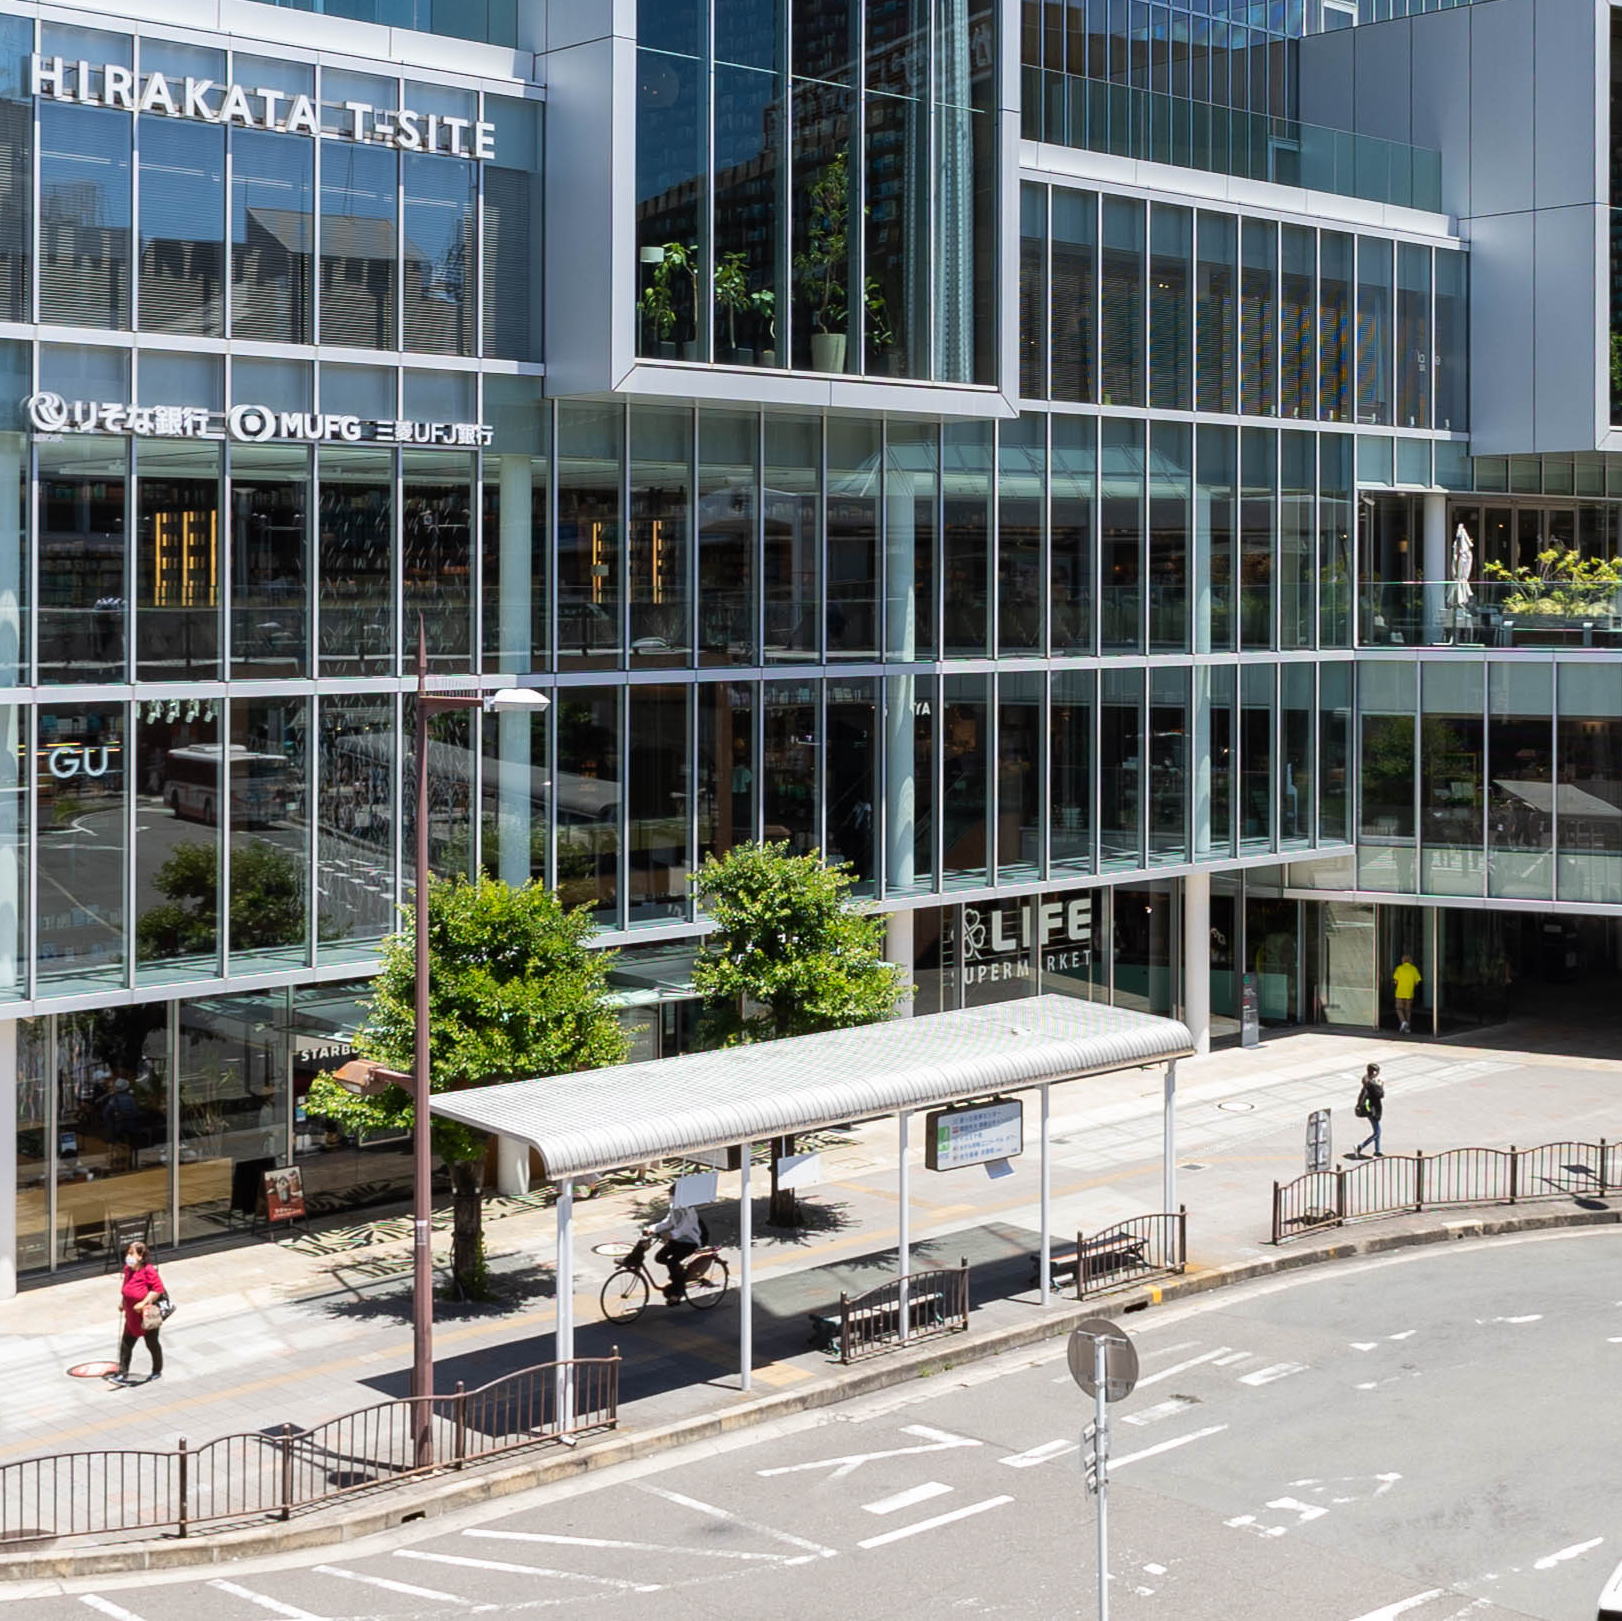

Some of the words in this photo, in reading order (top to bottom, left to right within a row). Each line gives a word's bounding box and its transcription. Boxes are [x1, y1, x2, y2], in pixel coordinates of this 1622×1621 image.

[31, 53, 319, 135] HIRAKATA
[345, 101, 496, 160] T-SITE
[74, 400, 210, 437] りそな銀行
[281, 412, 362, 441] MUFG
[375, 419, 494, 446] 三菱UFJ銀行
[49, 746, 108, 778] GU
[991, 898, 1092, 952] LIFE
[951, 949, 1091, 987] UPERMRKET
